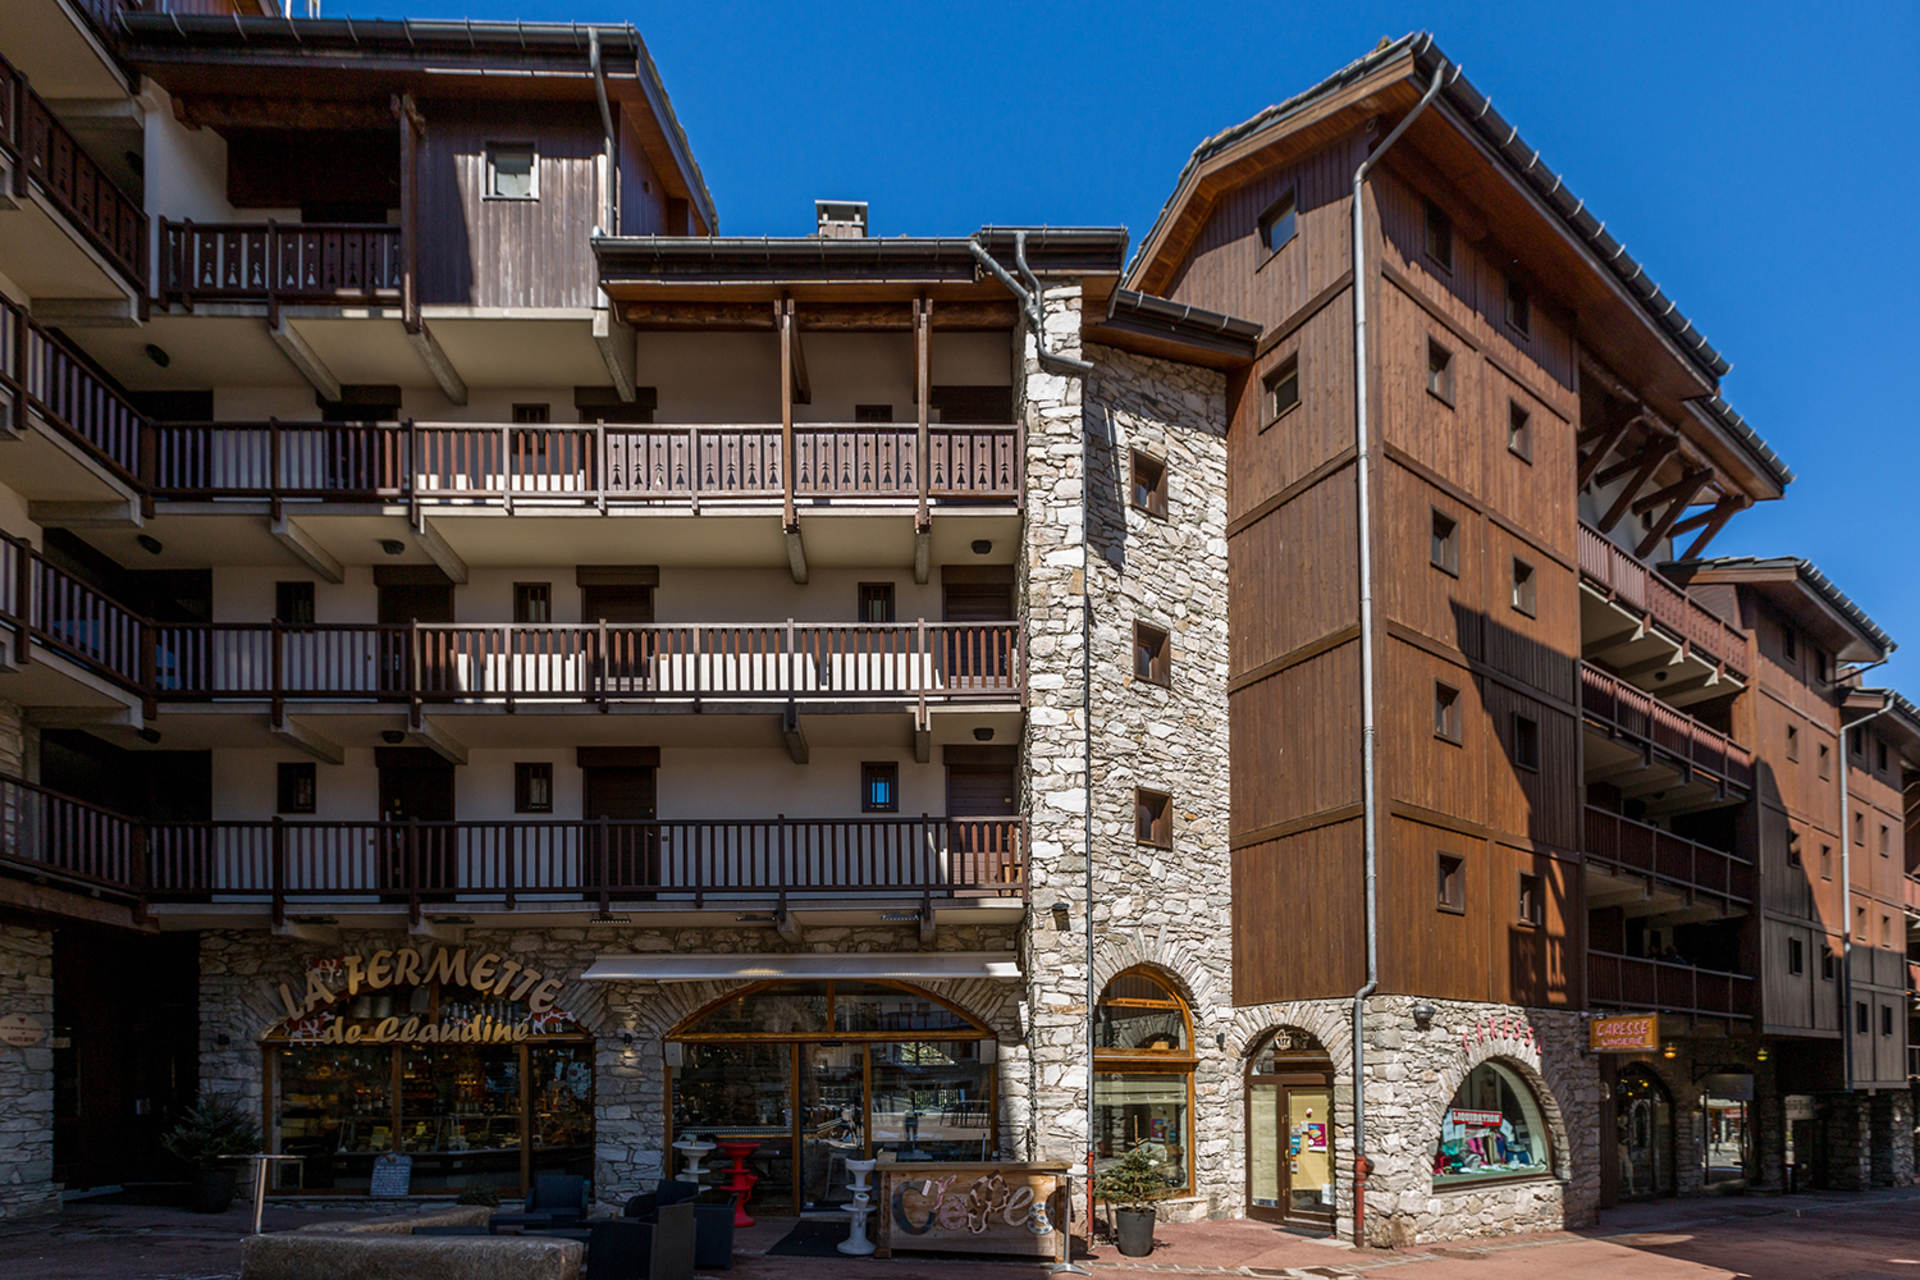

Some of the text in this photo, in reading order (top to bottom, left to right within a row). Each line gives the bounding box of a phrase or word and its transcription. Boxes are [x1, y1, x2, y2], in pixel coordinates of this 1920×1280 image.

[279, 946, 564, 1020] LA FERMETTE
[322, 1013, 529, 1045] de Claudine
[1596, 1020, 1649, 1036] CARESSE
[1601, 1036, 1644, 1046] LINGERIE
[1453, 1111, 1501, 1124] LIQUIDATION
